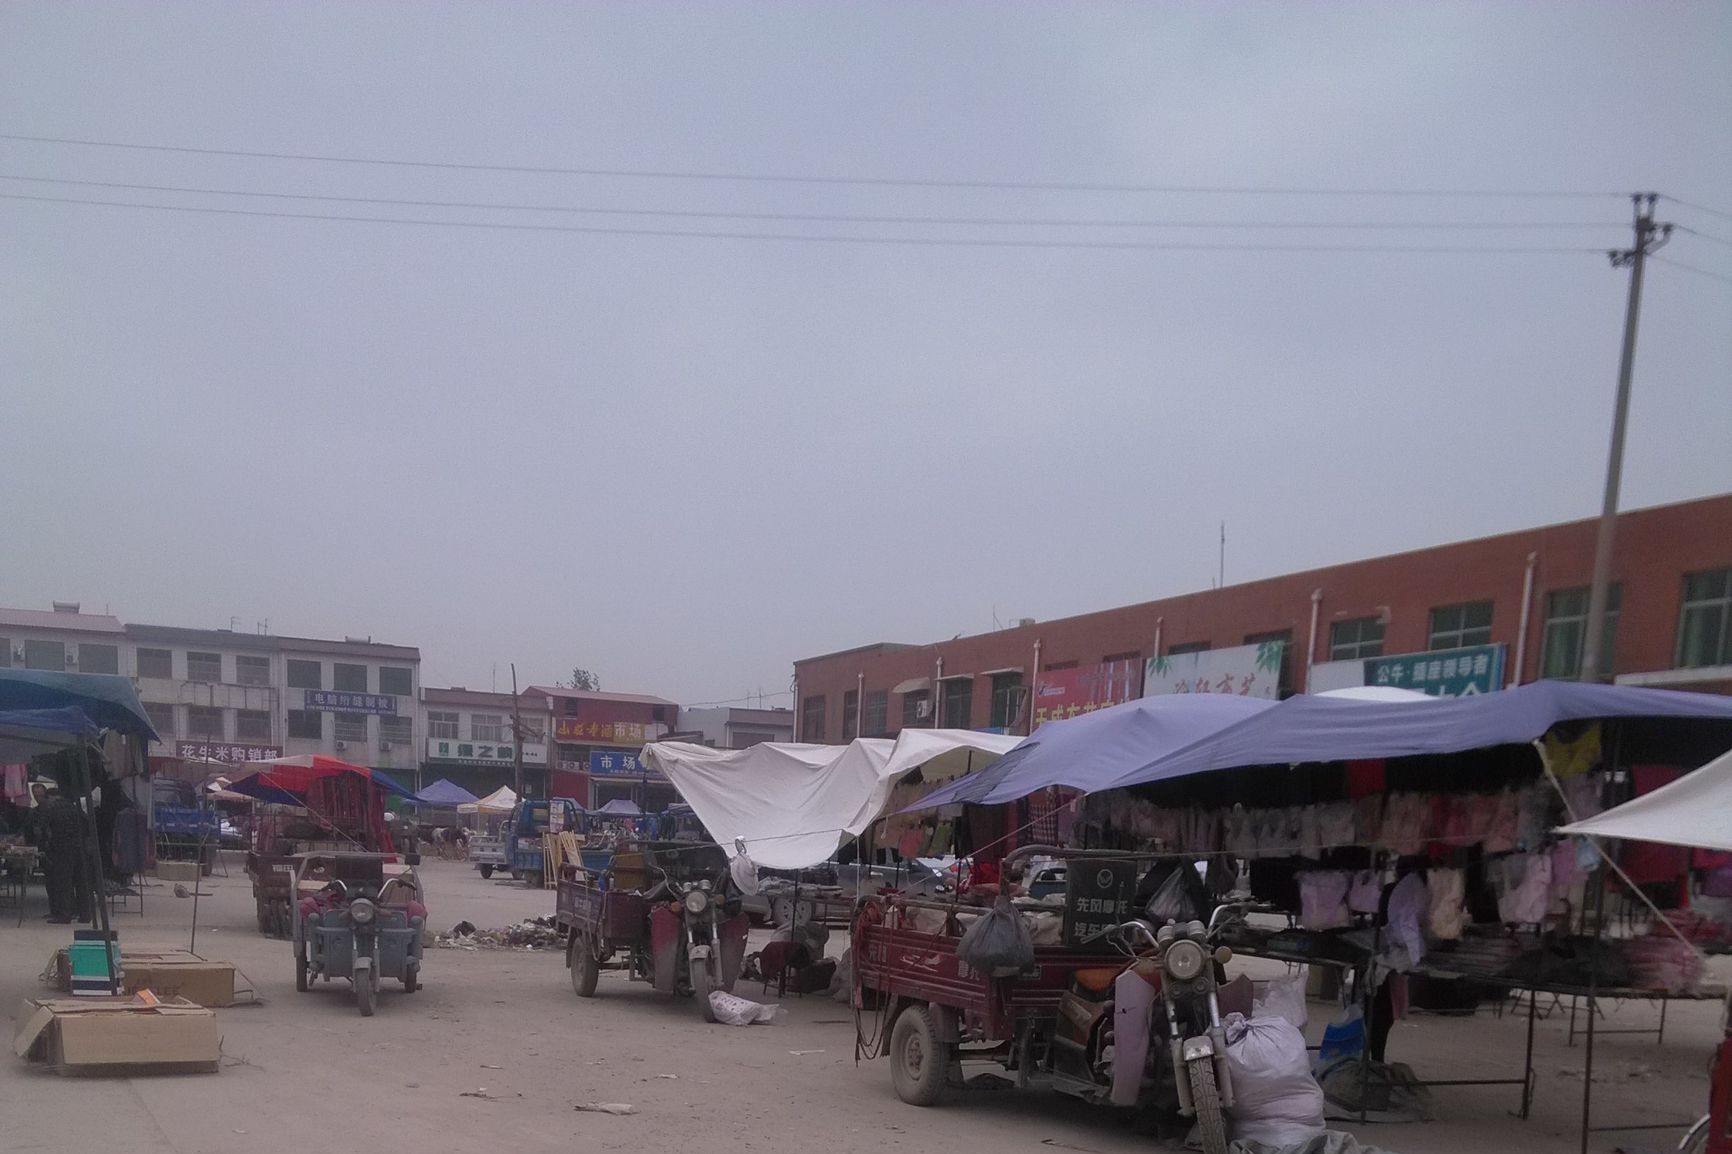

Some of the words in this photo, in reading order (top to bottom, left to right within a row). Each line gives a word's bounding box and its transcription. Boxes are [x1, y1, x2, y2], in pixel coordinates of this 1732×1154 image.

[181, 744, 278, 761] 花生米购销部
